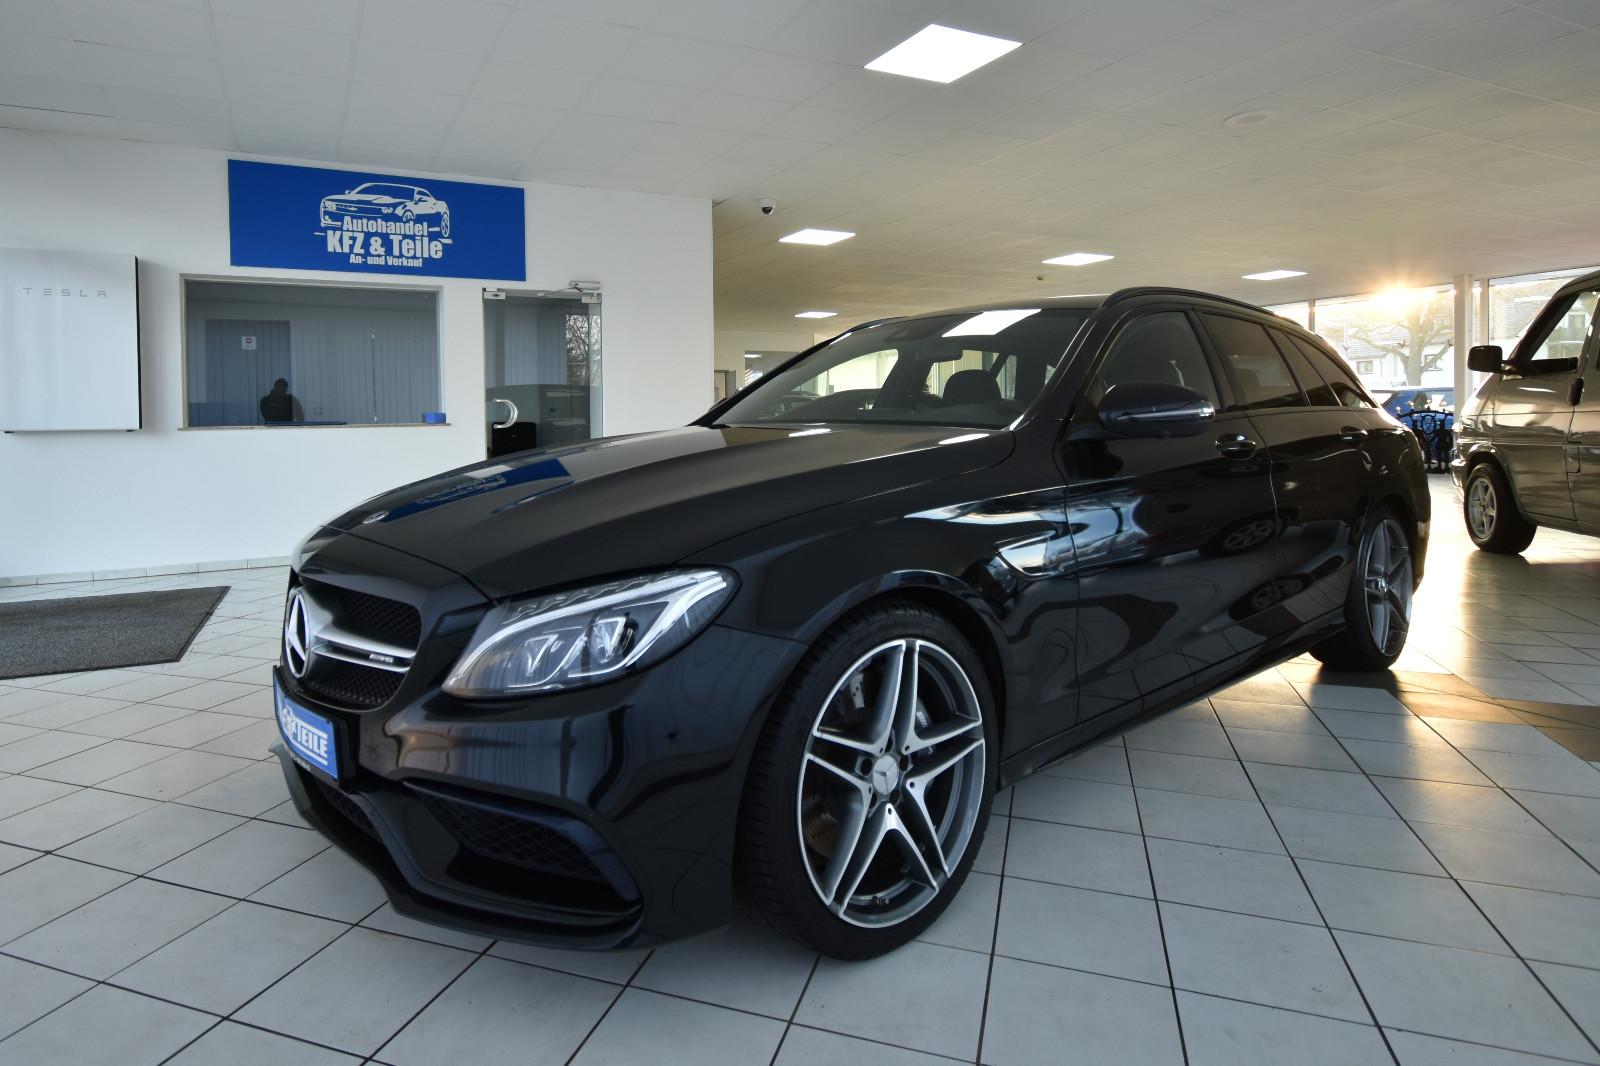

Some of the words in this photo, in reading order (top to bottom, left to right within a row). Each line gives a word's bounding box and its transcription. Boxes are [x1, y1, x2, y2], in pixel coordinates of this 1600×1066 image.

[343, 216, 427, 235] Autohandel
[327, 230, 364, 253] KFZ
[371, 238, 385, 255] &
[391, 235, 443, 258] Teile
[350, 254, 365, 264] An-
[367, 256, 385, 265] und
[387, 256, 423, 266] Verkauf
[22, 287, 107, 298] TESLA
[296, 721, 328, 757] TEILE
